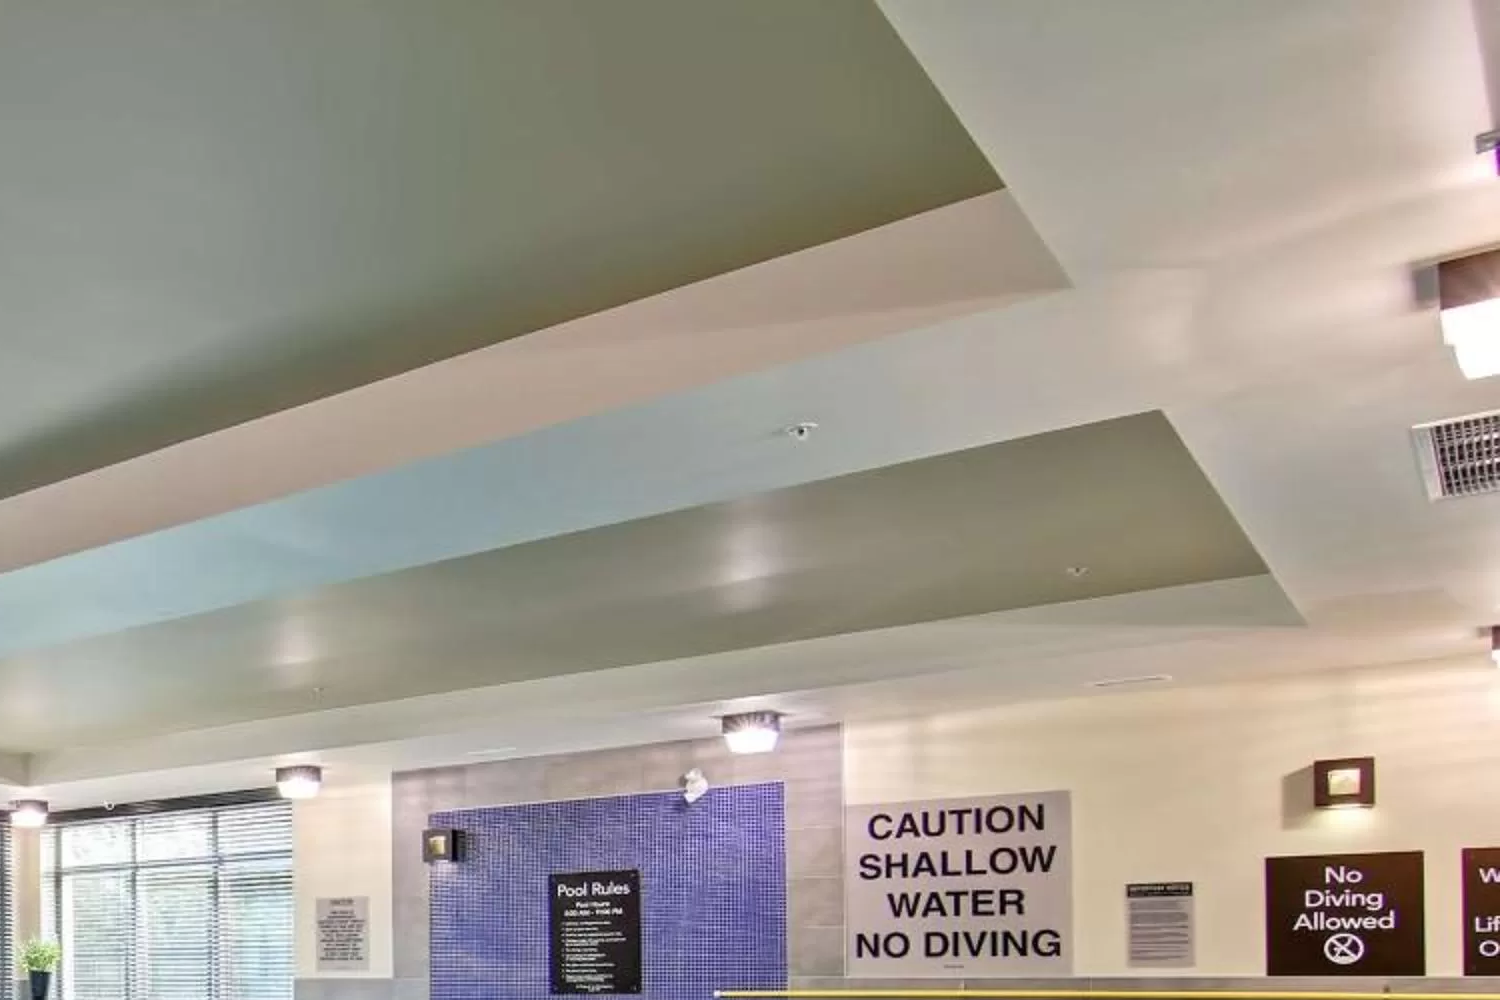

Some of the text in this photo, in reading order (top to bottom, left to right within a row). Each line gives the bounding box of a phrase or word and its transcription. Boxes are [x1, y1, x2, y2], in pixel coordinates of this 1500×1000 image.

[868, 804, 1044, 840] CAUTION
[859, 846, 1057, 880] SHALLOW
[1325, 866, 1363, 884] No
[557, 881, 630, 897] Pool Rules
[1305, 889, 1383, 911] Diving
[887, 889, 1025, 919] WATER
[1293, 911, 1395, 931] Allowed
[856, 929, 1061, 958] NO DIVING
